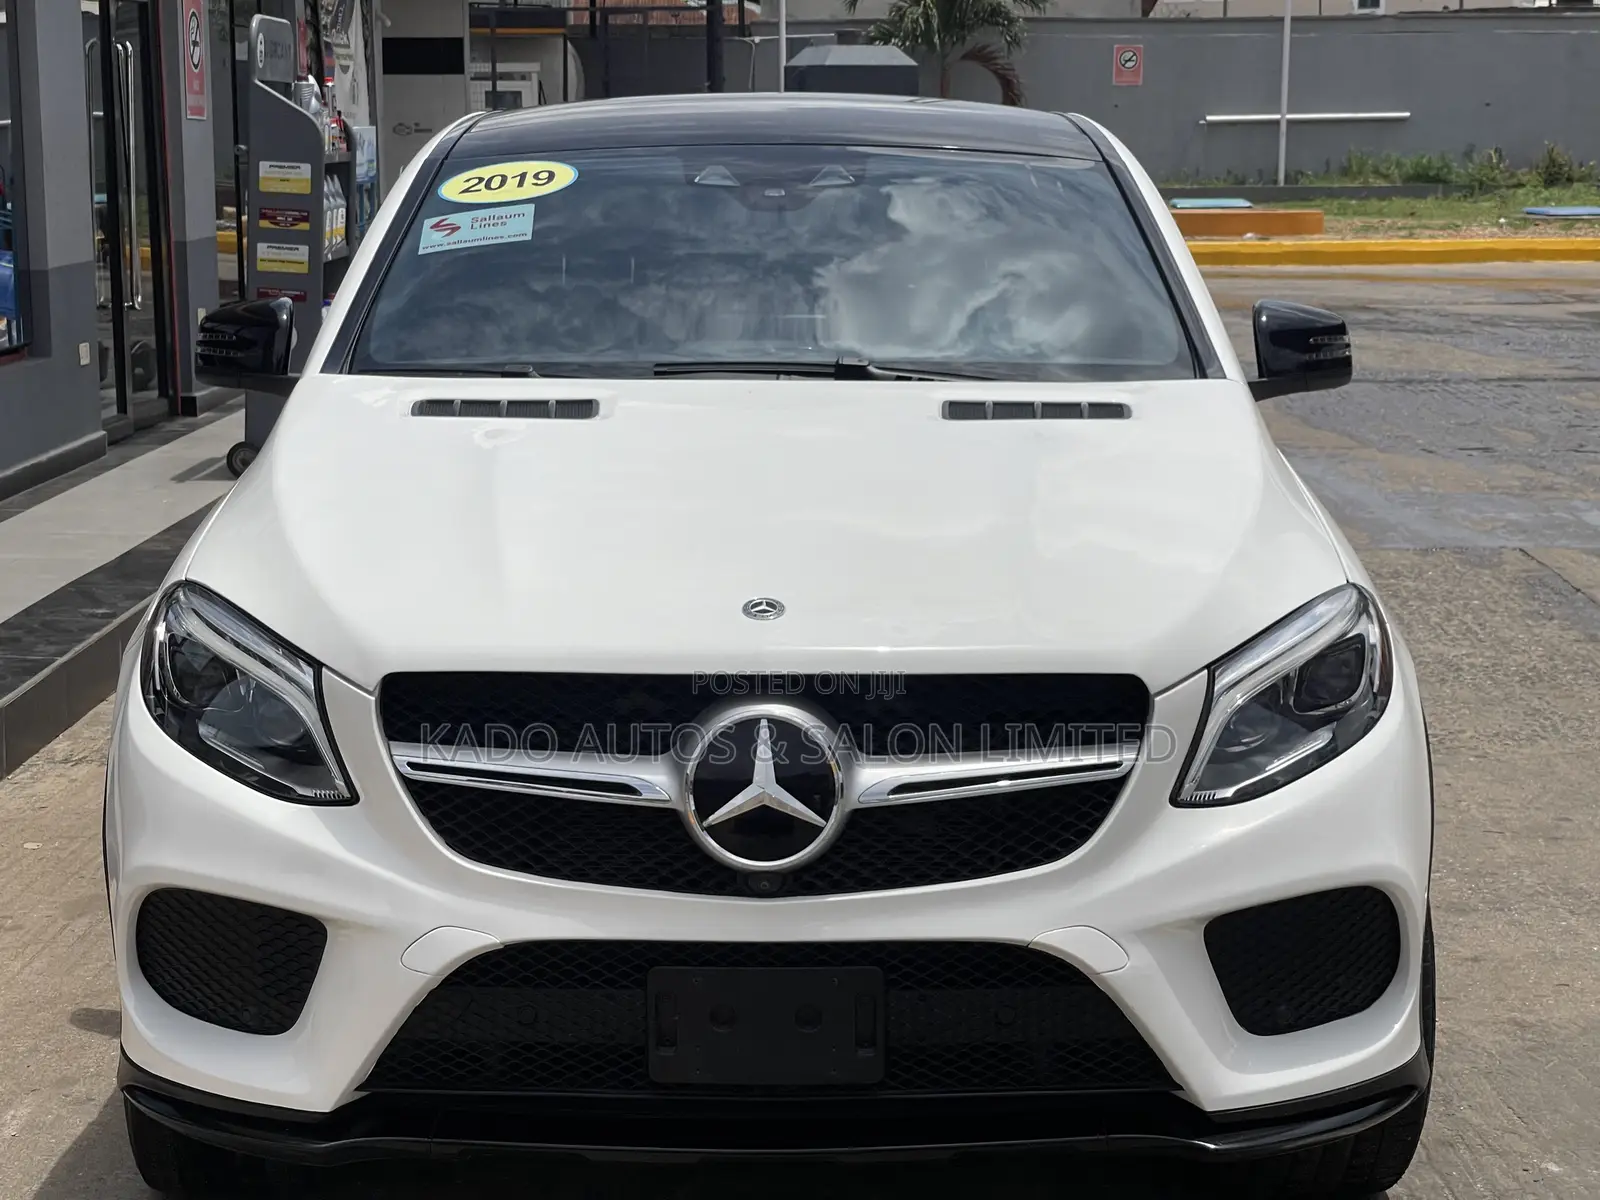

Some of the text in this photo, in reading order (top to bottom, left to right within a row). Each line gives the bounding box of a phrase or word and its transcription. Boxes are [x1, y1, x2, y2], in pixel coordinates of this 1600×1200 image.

[458, 169, 556, 195] 2019
[470, 212, 526, 224] Sallaum
[470, 221, 508, 230] Lines
[421, 232, 528, 250] www.sallaumlines.com
